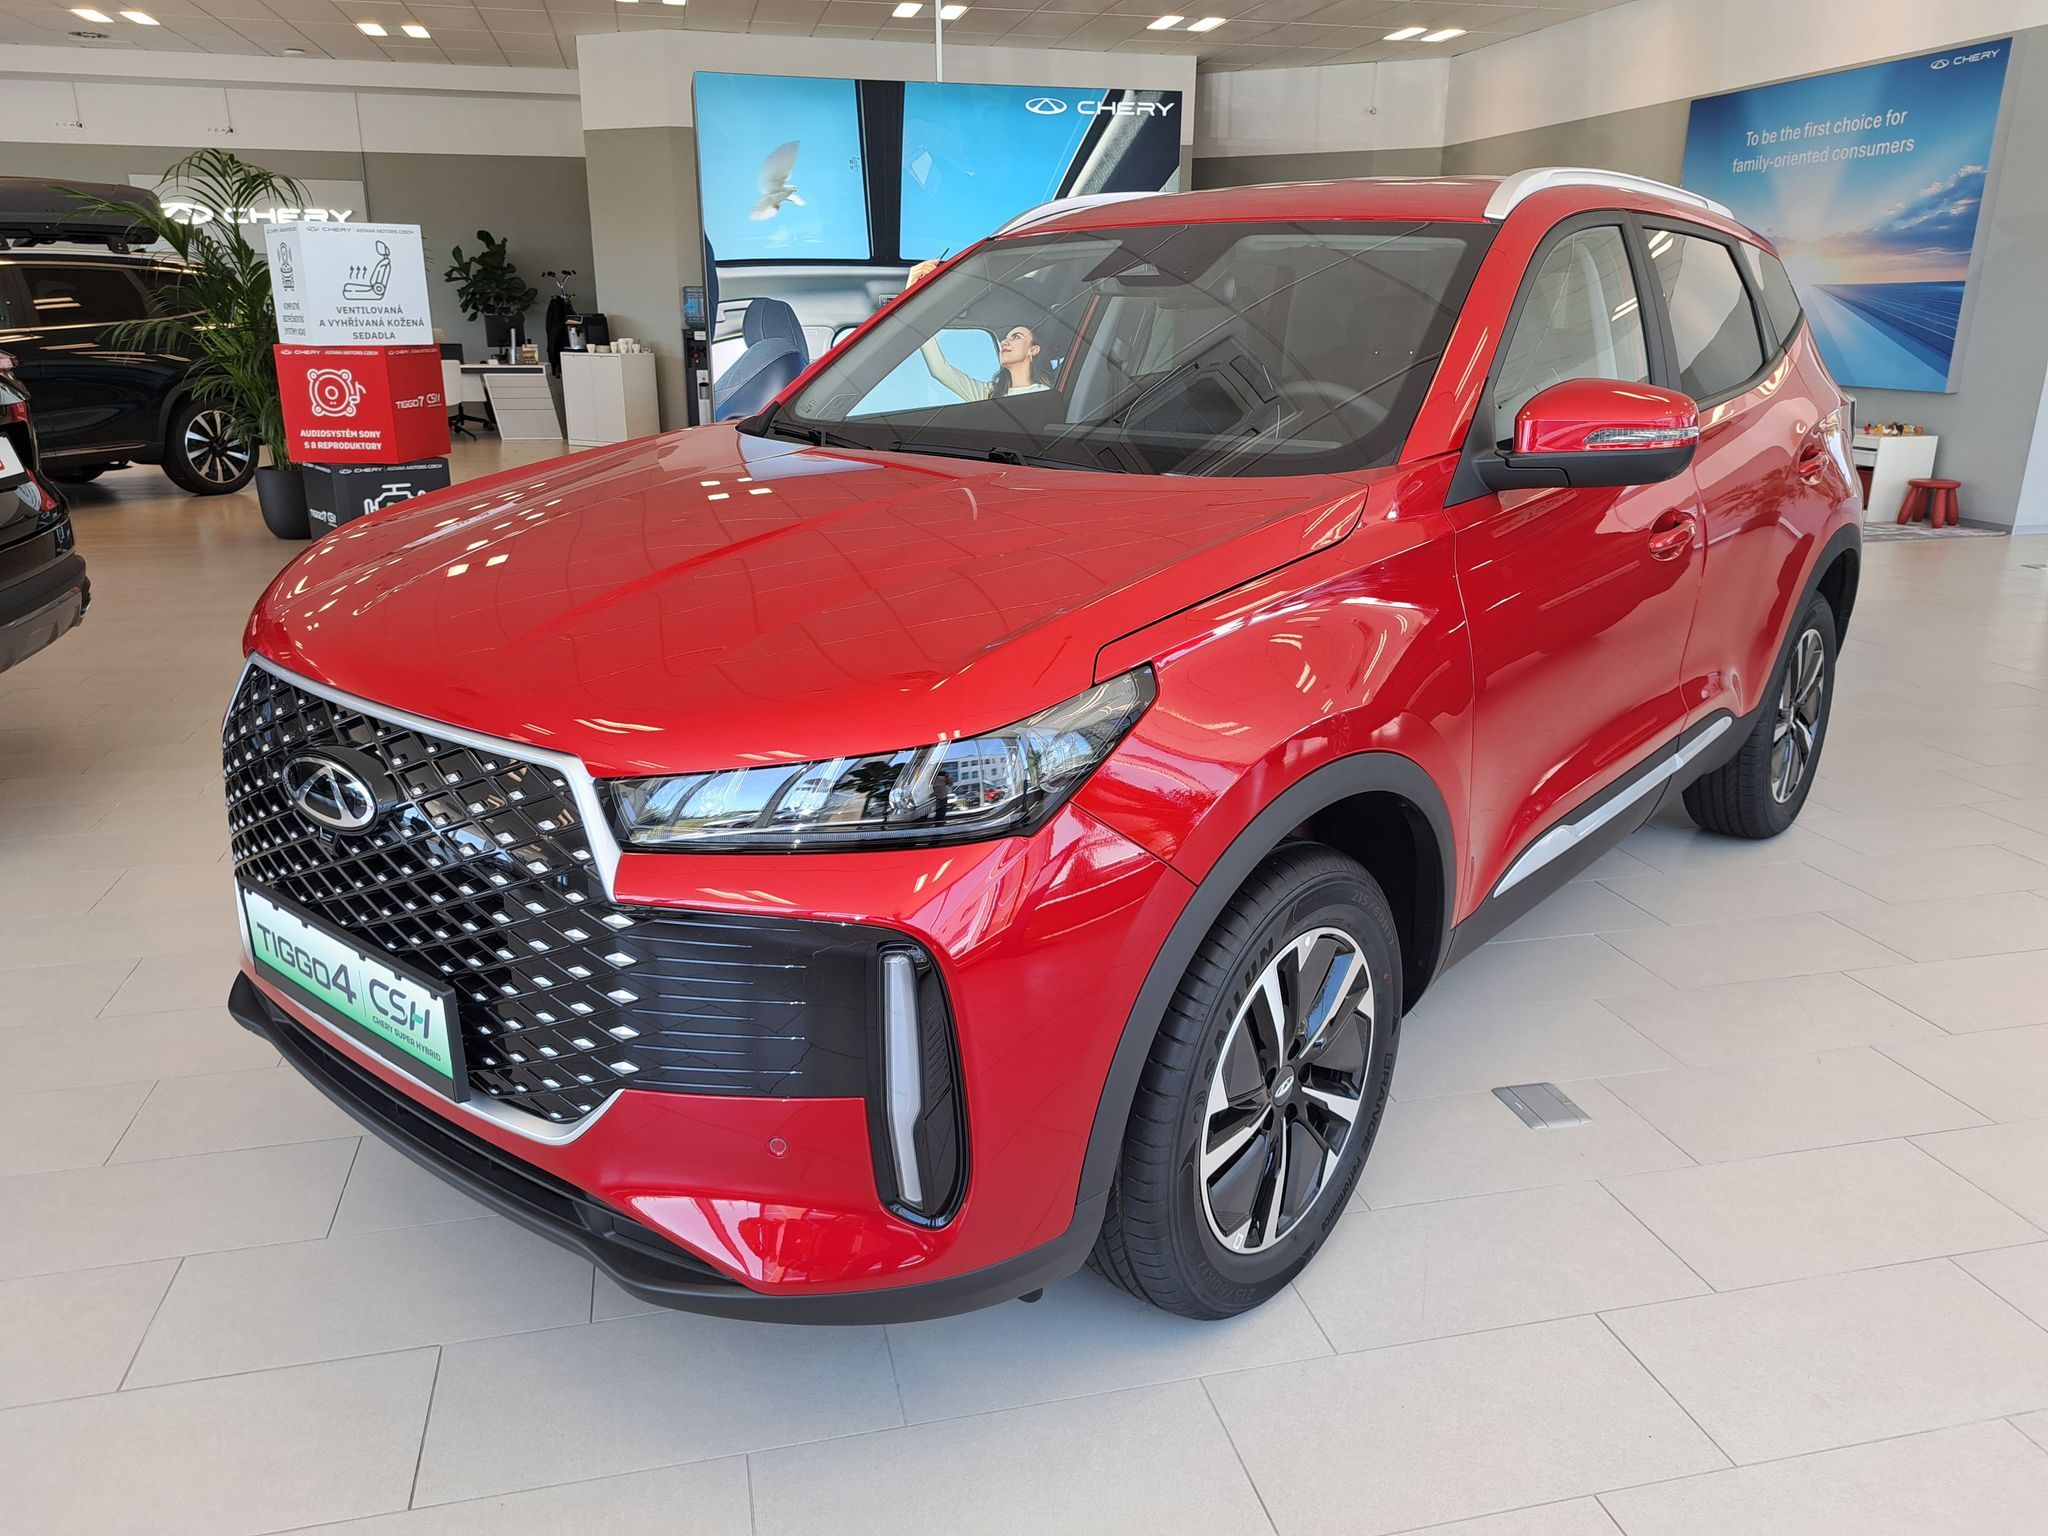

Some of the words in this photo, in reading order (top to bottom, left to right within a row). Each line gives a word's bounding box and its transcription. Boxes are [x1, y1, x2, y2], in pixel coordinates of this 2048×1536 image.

[1953, 48, 2000, 65] CHERY
[1077, 100, 1175, 116] CHERY
[1746, 131, 1759, 147] To
[1761, 129, 1777, 145] be
[1780, 125, 1801, 142] the
[1803, 120, 1831, 138] first
[1833, 114, 1882, 134] choice
[1885, 109, 1908, 127] for
[1732, 147, 1830, 173] family-oriented
[1832, 138, 1915, 161] consumers
[223, 207, 352, 224] CHERY
[336, 304, 403, 315] VENTILOVANÁ
[319, 320, 326, 328] A
[328, 317, 385, 328] VYHŘÍVANÁ
[387, 317, 425, 328] KOŽENÁ
[352, 331, 396, 340] SEDADLA
[300, 428, 358, 438] AUDIOSYSTÉM
[359, 430, 381, 438] SONY
[304, 441, 310, 449] S
[311, 441, 316, 449] 8
[317, 441, 382, 450] REPRODUKTORY
[256, 921, 357, 1005] TIGGO4
[369, 978, 431, 1039] CSH
[1203, 937, 1274, 1084] SAILUN
[373, 1015, 394, 1033] CHERY
[394, 1028, 415, 1047] SUPER
[415, 1040, 441, 1062] HYBRID
[1321, 1156, 1362, 1232] Performance
